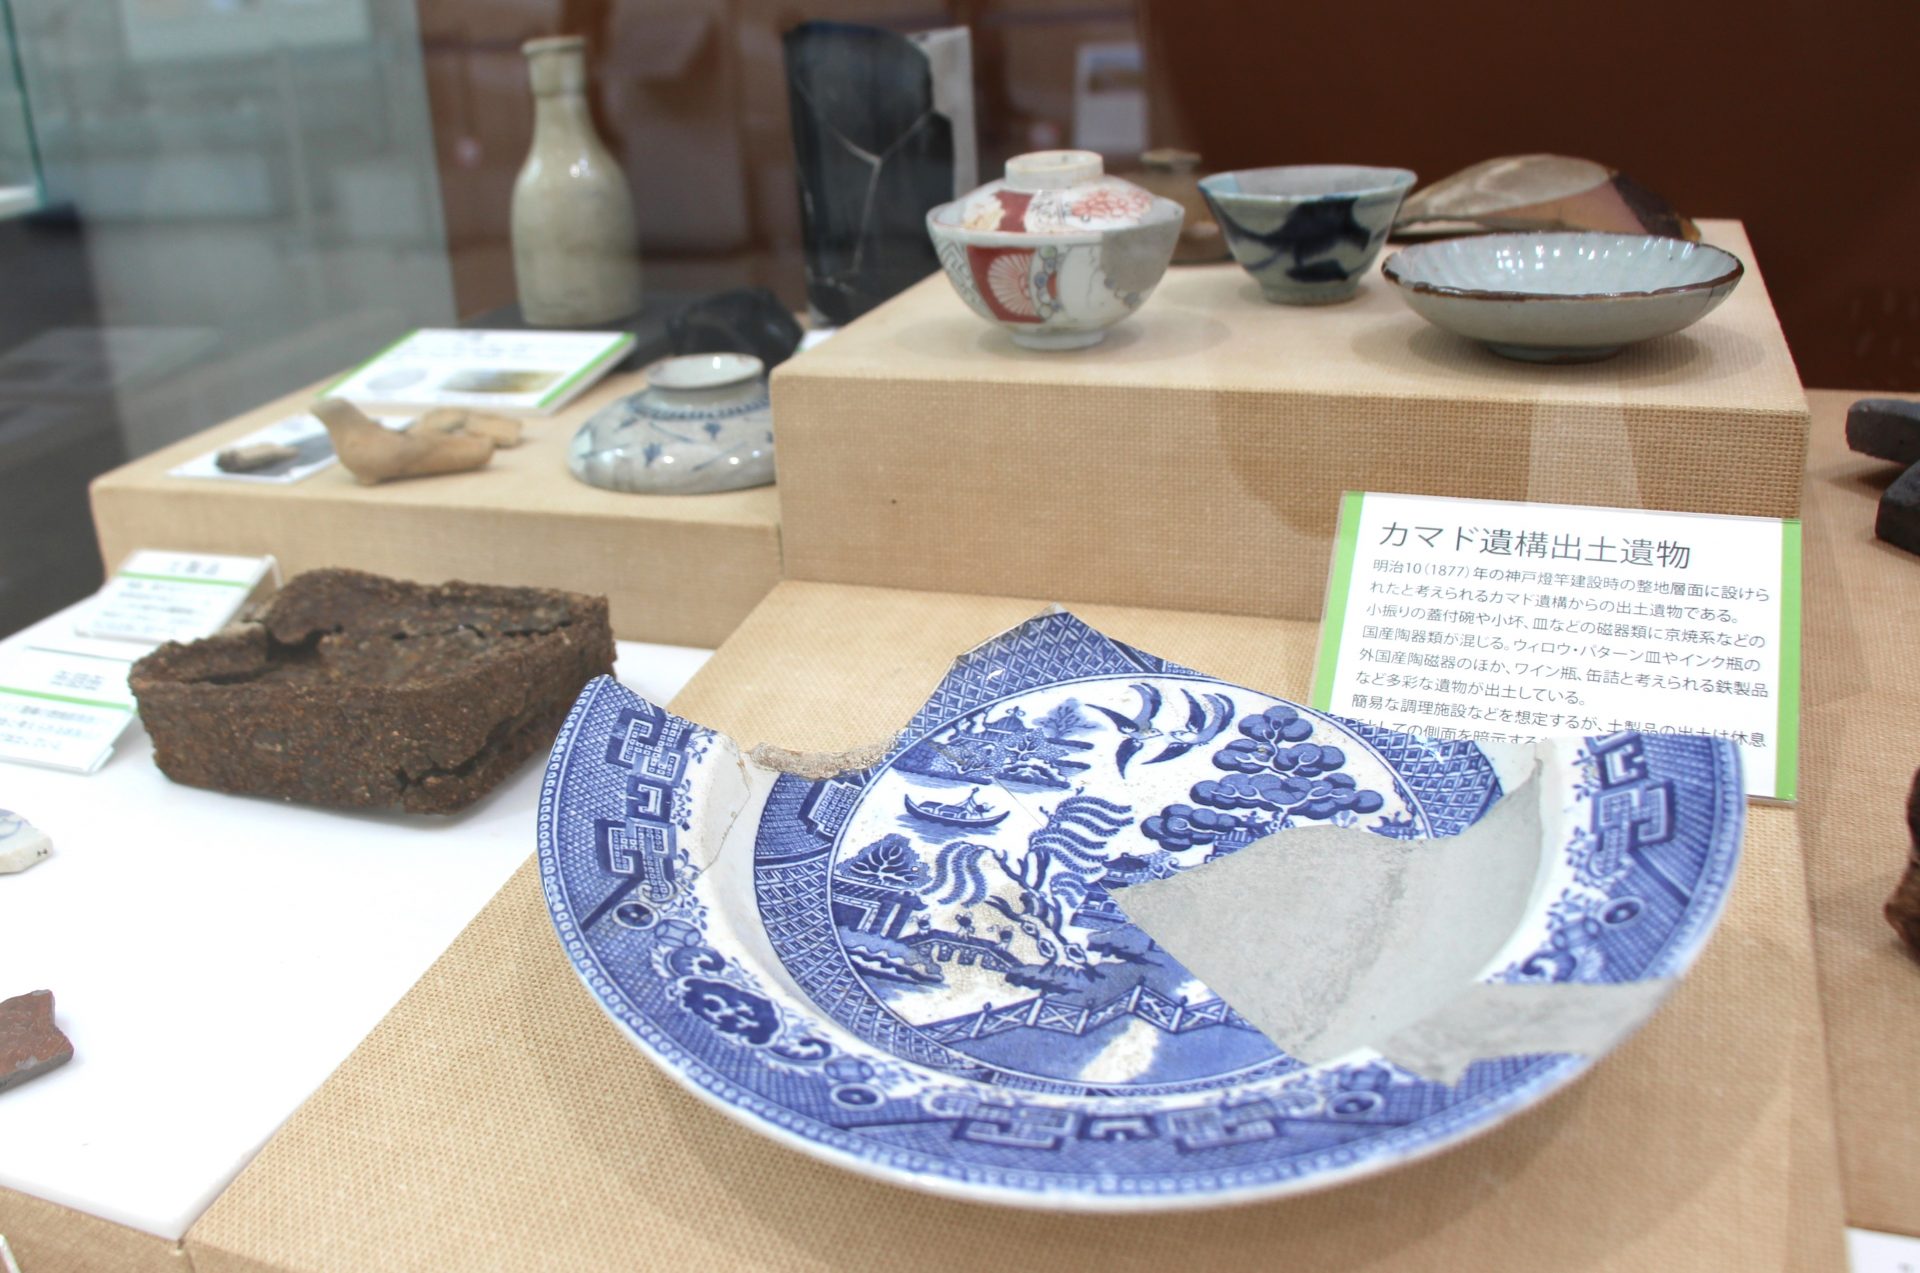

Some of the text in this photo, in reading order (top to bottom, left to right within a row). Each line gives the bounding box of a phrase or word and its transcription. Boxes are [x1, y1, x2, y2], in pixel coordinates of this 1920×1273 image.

[1379, 521, 1691, 570] カマド遺構出土遺物
[1369, 580, 1738, 624] れたと考えられるカマド遺構からの出土遺物である。
[1355, 670, 1586, 706] など多彩な遺物が出土している。
